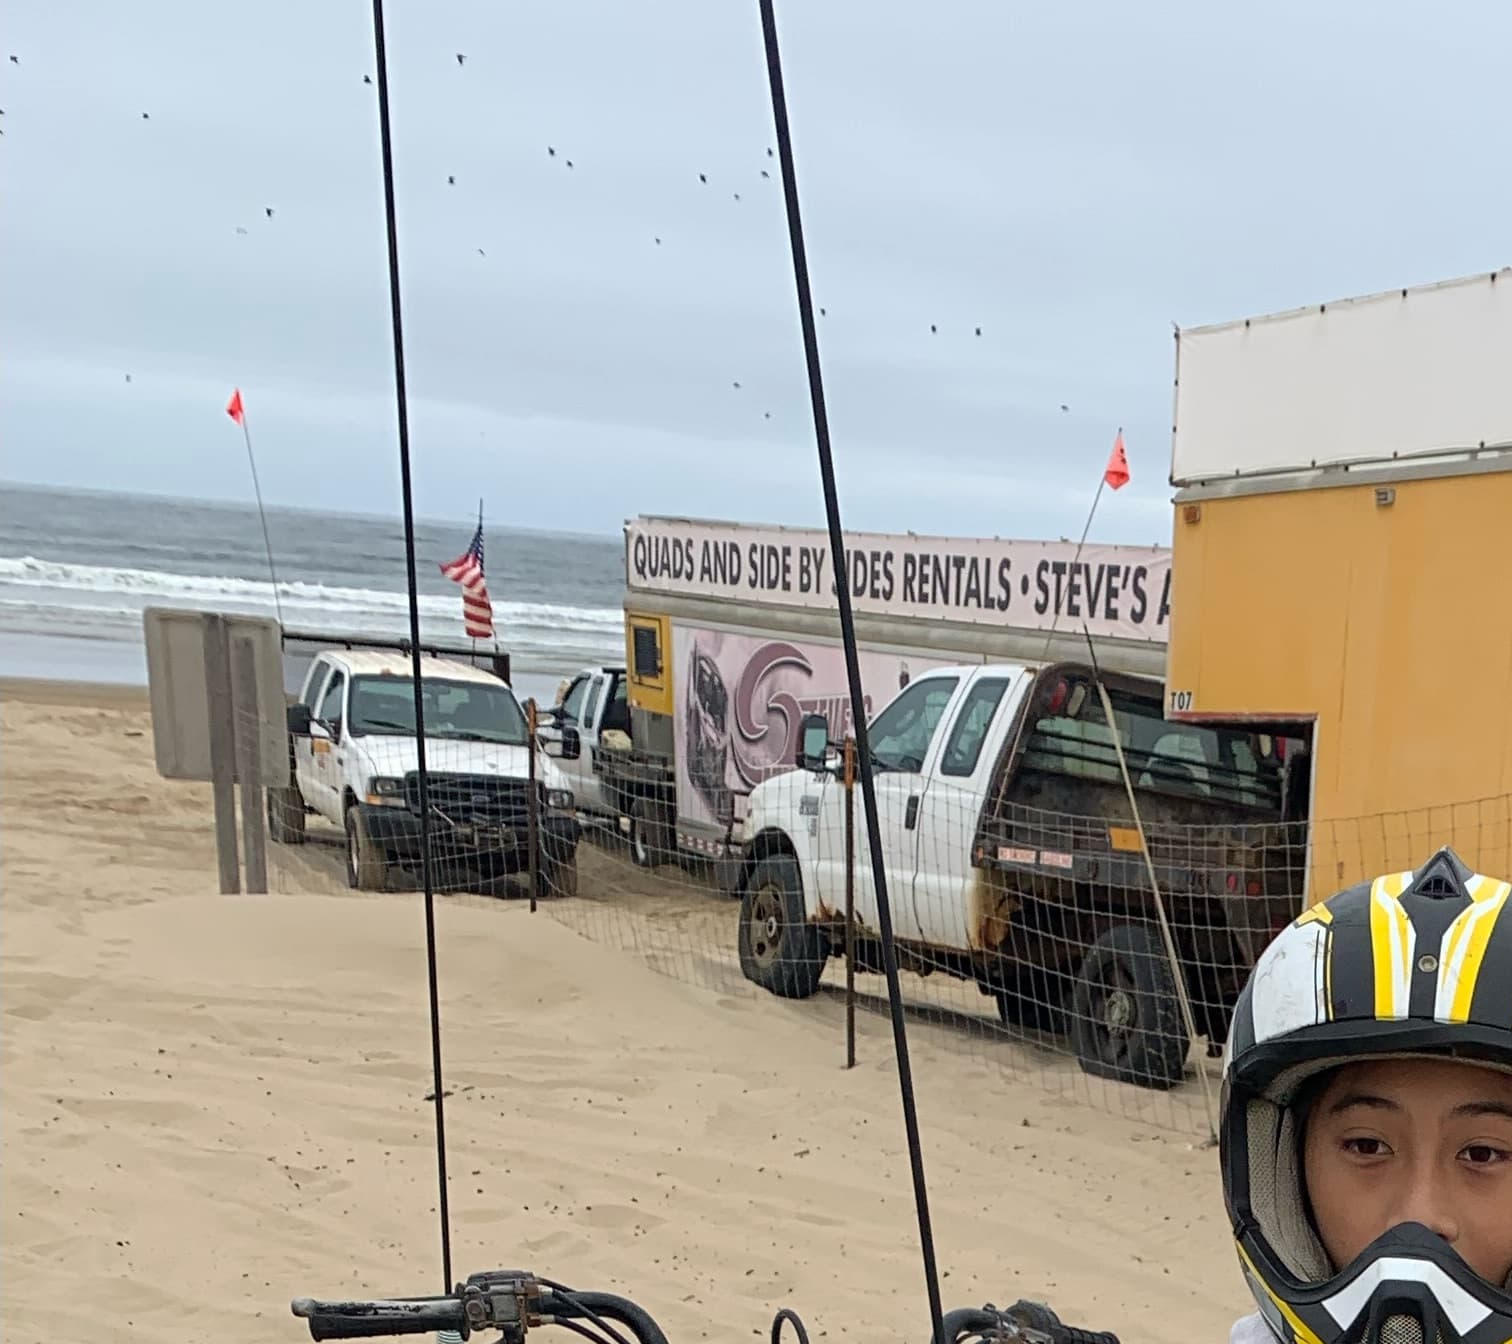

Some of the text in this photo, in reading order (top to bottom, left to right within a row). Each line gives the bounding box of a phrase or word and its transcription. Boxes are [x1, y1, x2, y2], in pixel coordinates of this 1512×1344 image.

[634, 533, 694, 581] QUADS
[700, 540, 742, 585] AND
[750, 543, 791, 591] SIDE
[799, 546, 826, 594] BY
[832, 549, 894, 601] IDES
[903, 553, 1011, 612] RENTALS
[1034, 559, 1147, 624] STEVE'S
